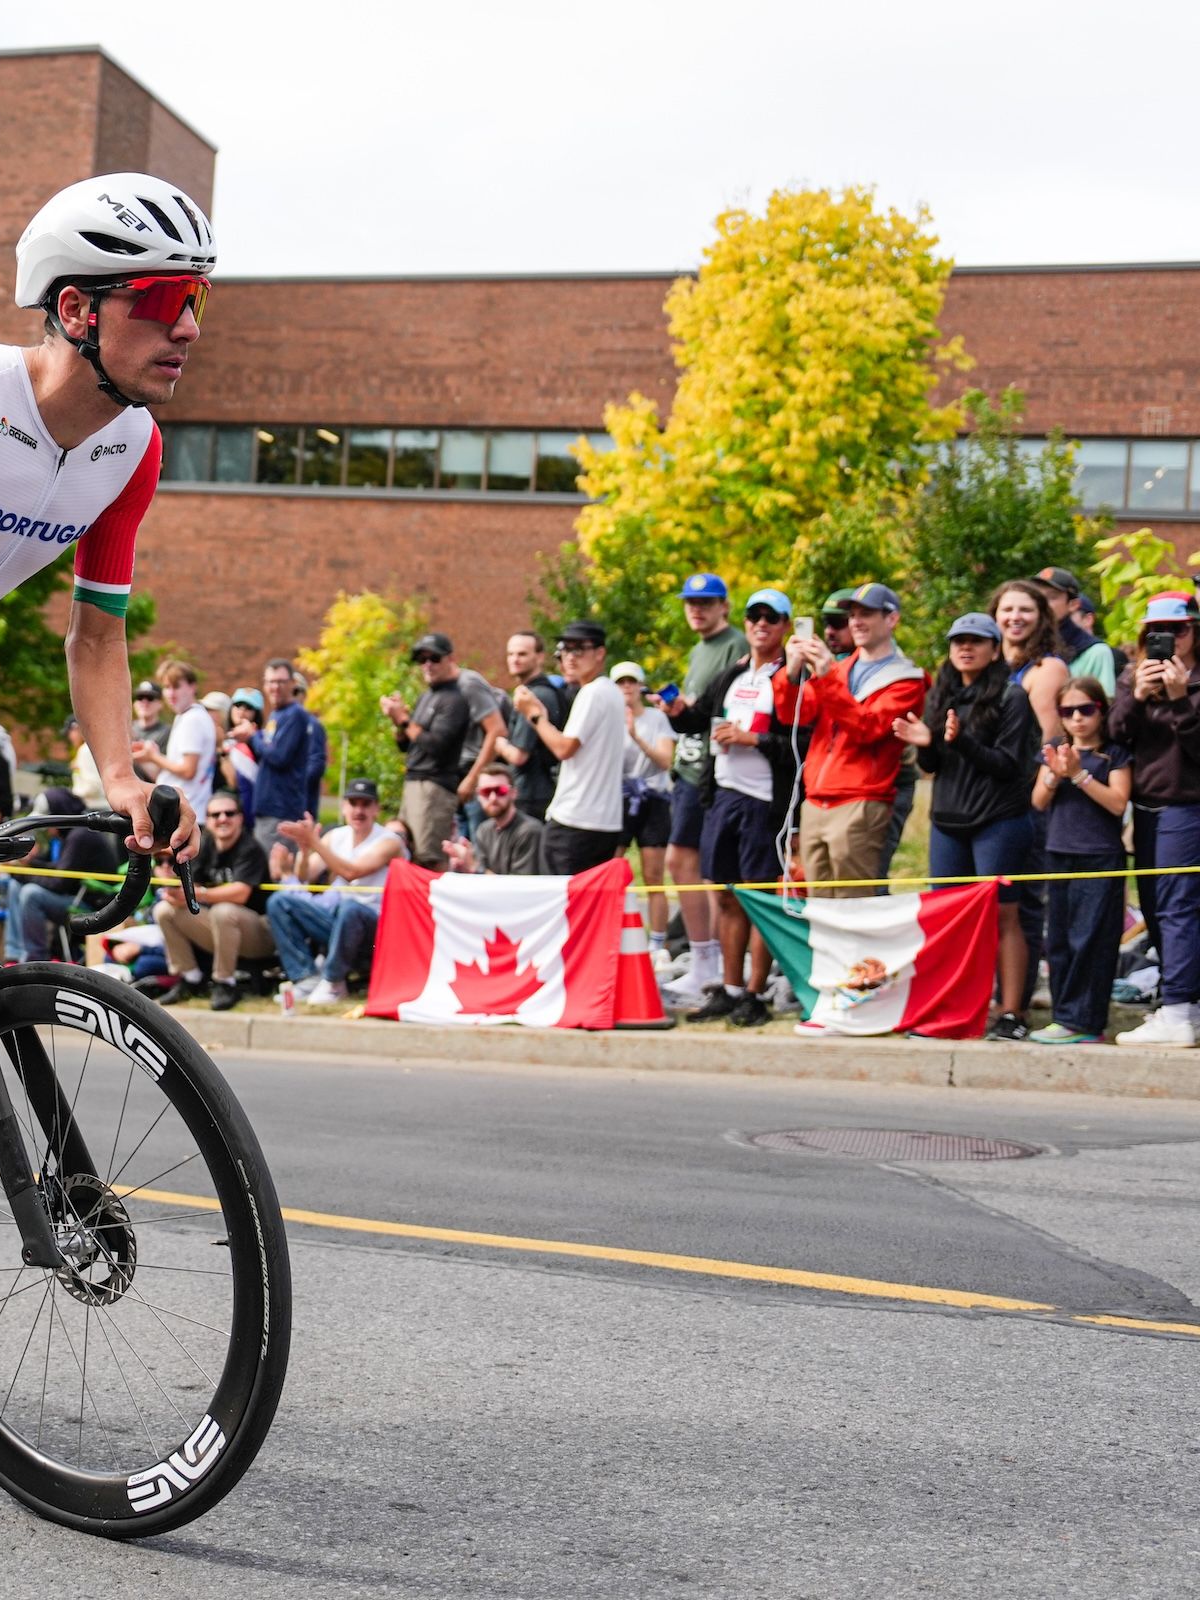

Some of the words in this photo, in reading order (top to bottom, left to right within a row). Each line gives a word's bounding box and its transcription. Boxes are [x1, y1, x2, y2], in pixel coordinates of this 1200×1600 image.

[97, 193, 153, 233] MET
[9, 428, 37, 450] CICLISMO
[102, 443, 127, 456] PACTO
